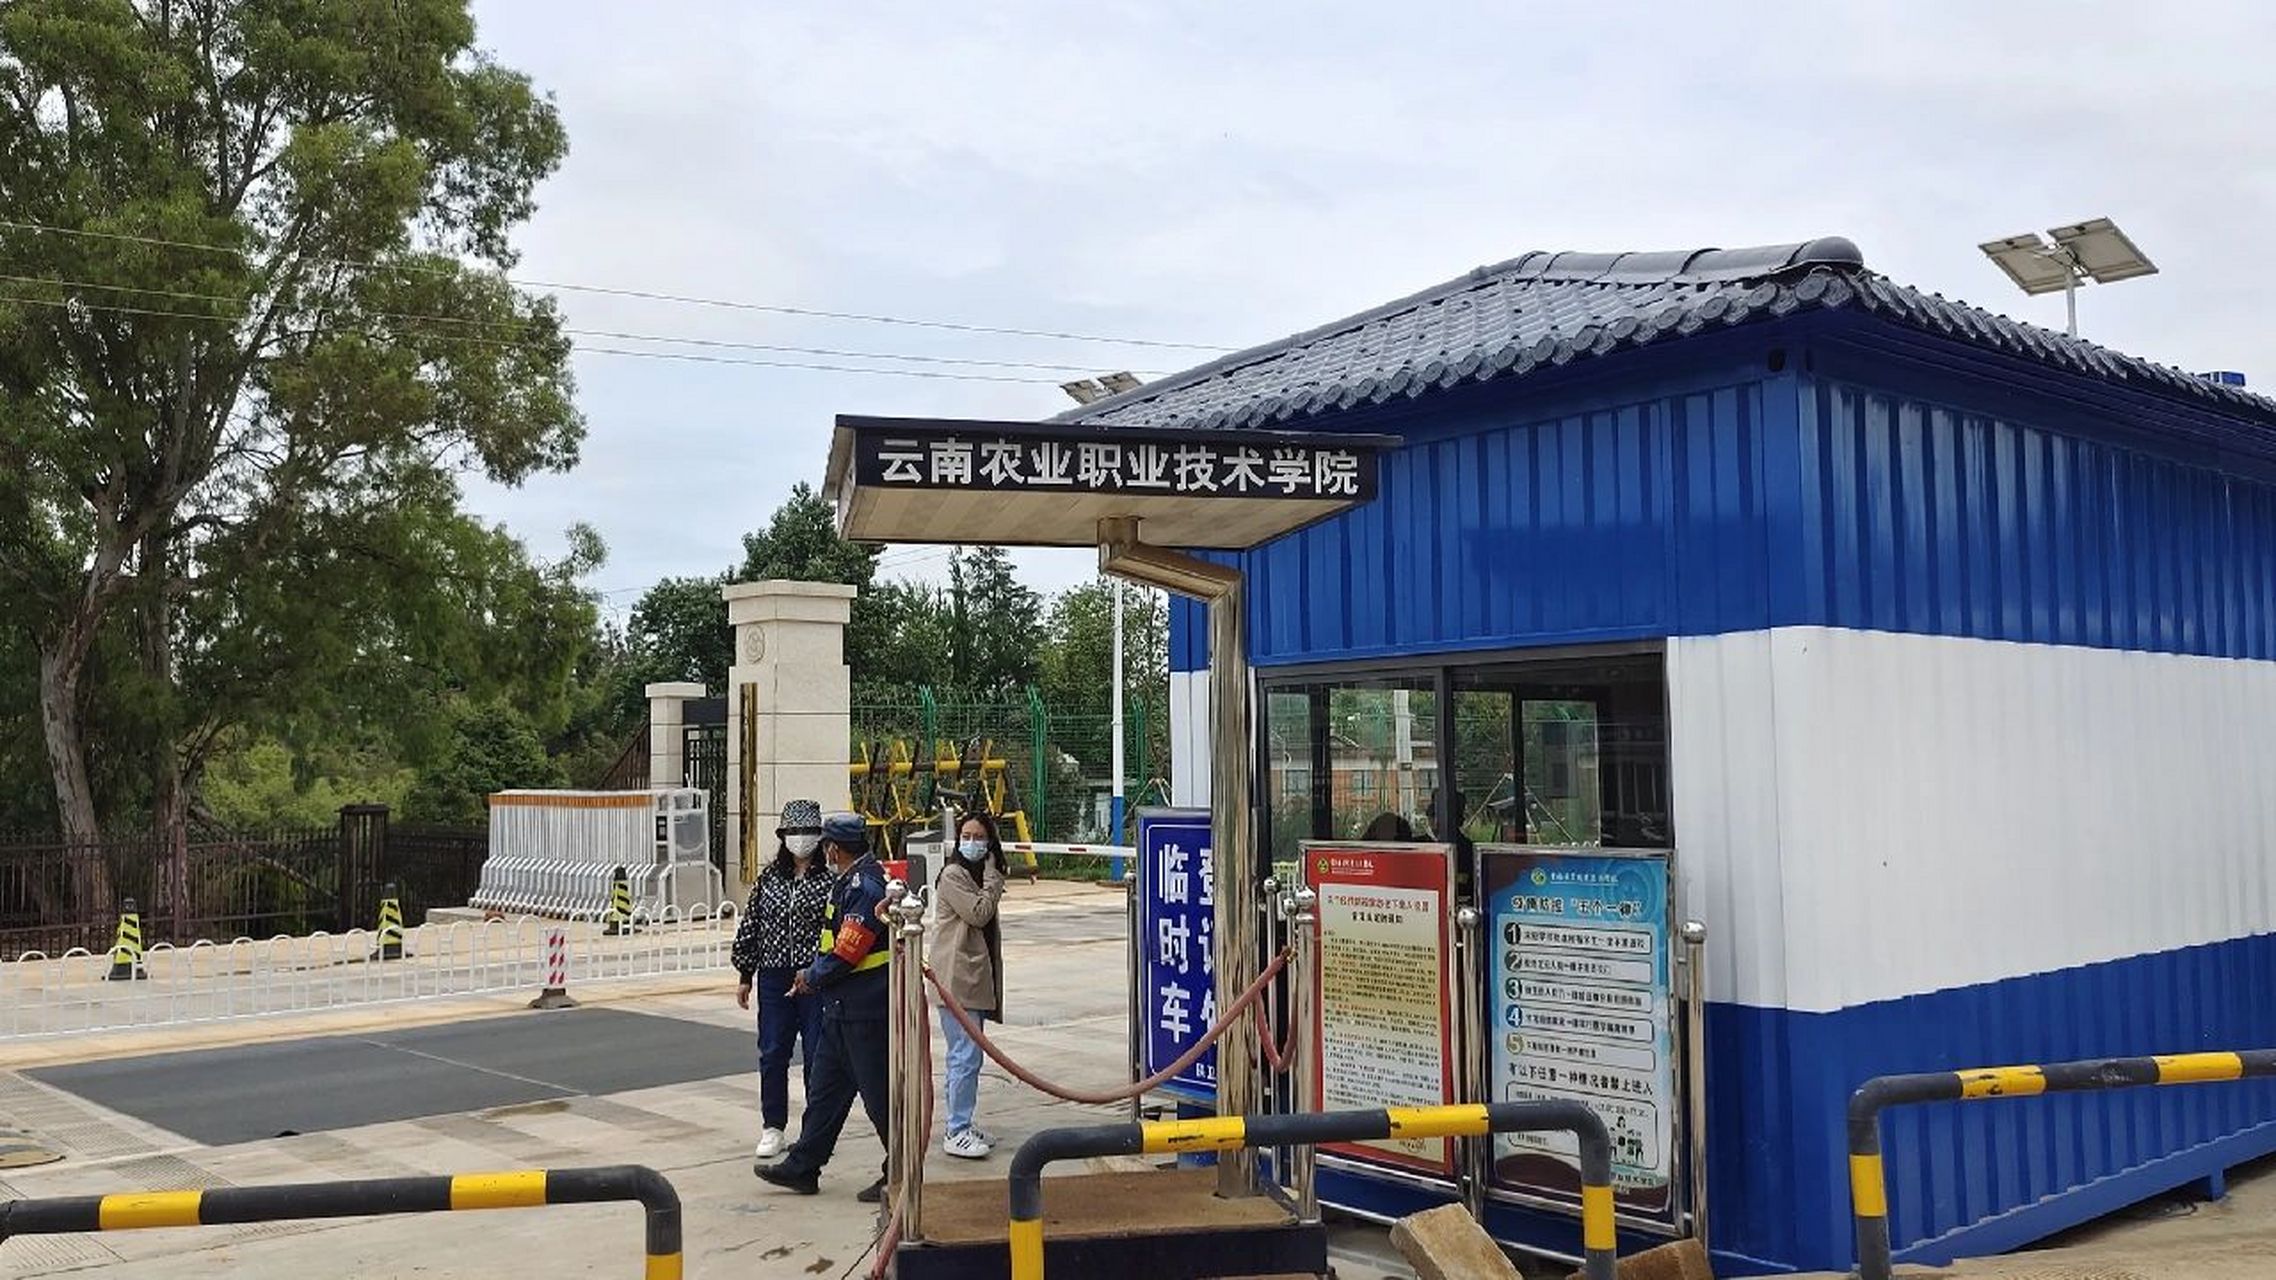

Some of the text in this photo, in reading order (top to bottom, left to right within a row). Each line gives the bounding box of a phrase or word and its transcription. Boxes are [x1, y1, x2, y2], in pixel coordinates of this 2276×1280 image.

[878, 438, 1359, 493] 云南农业职业技术学院
[1158, 844, 1190, 1044] 临时车
